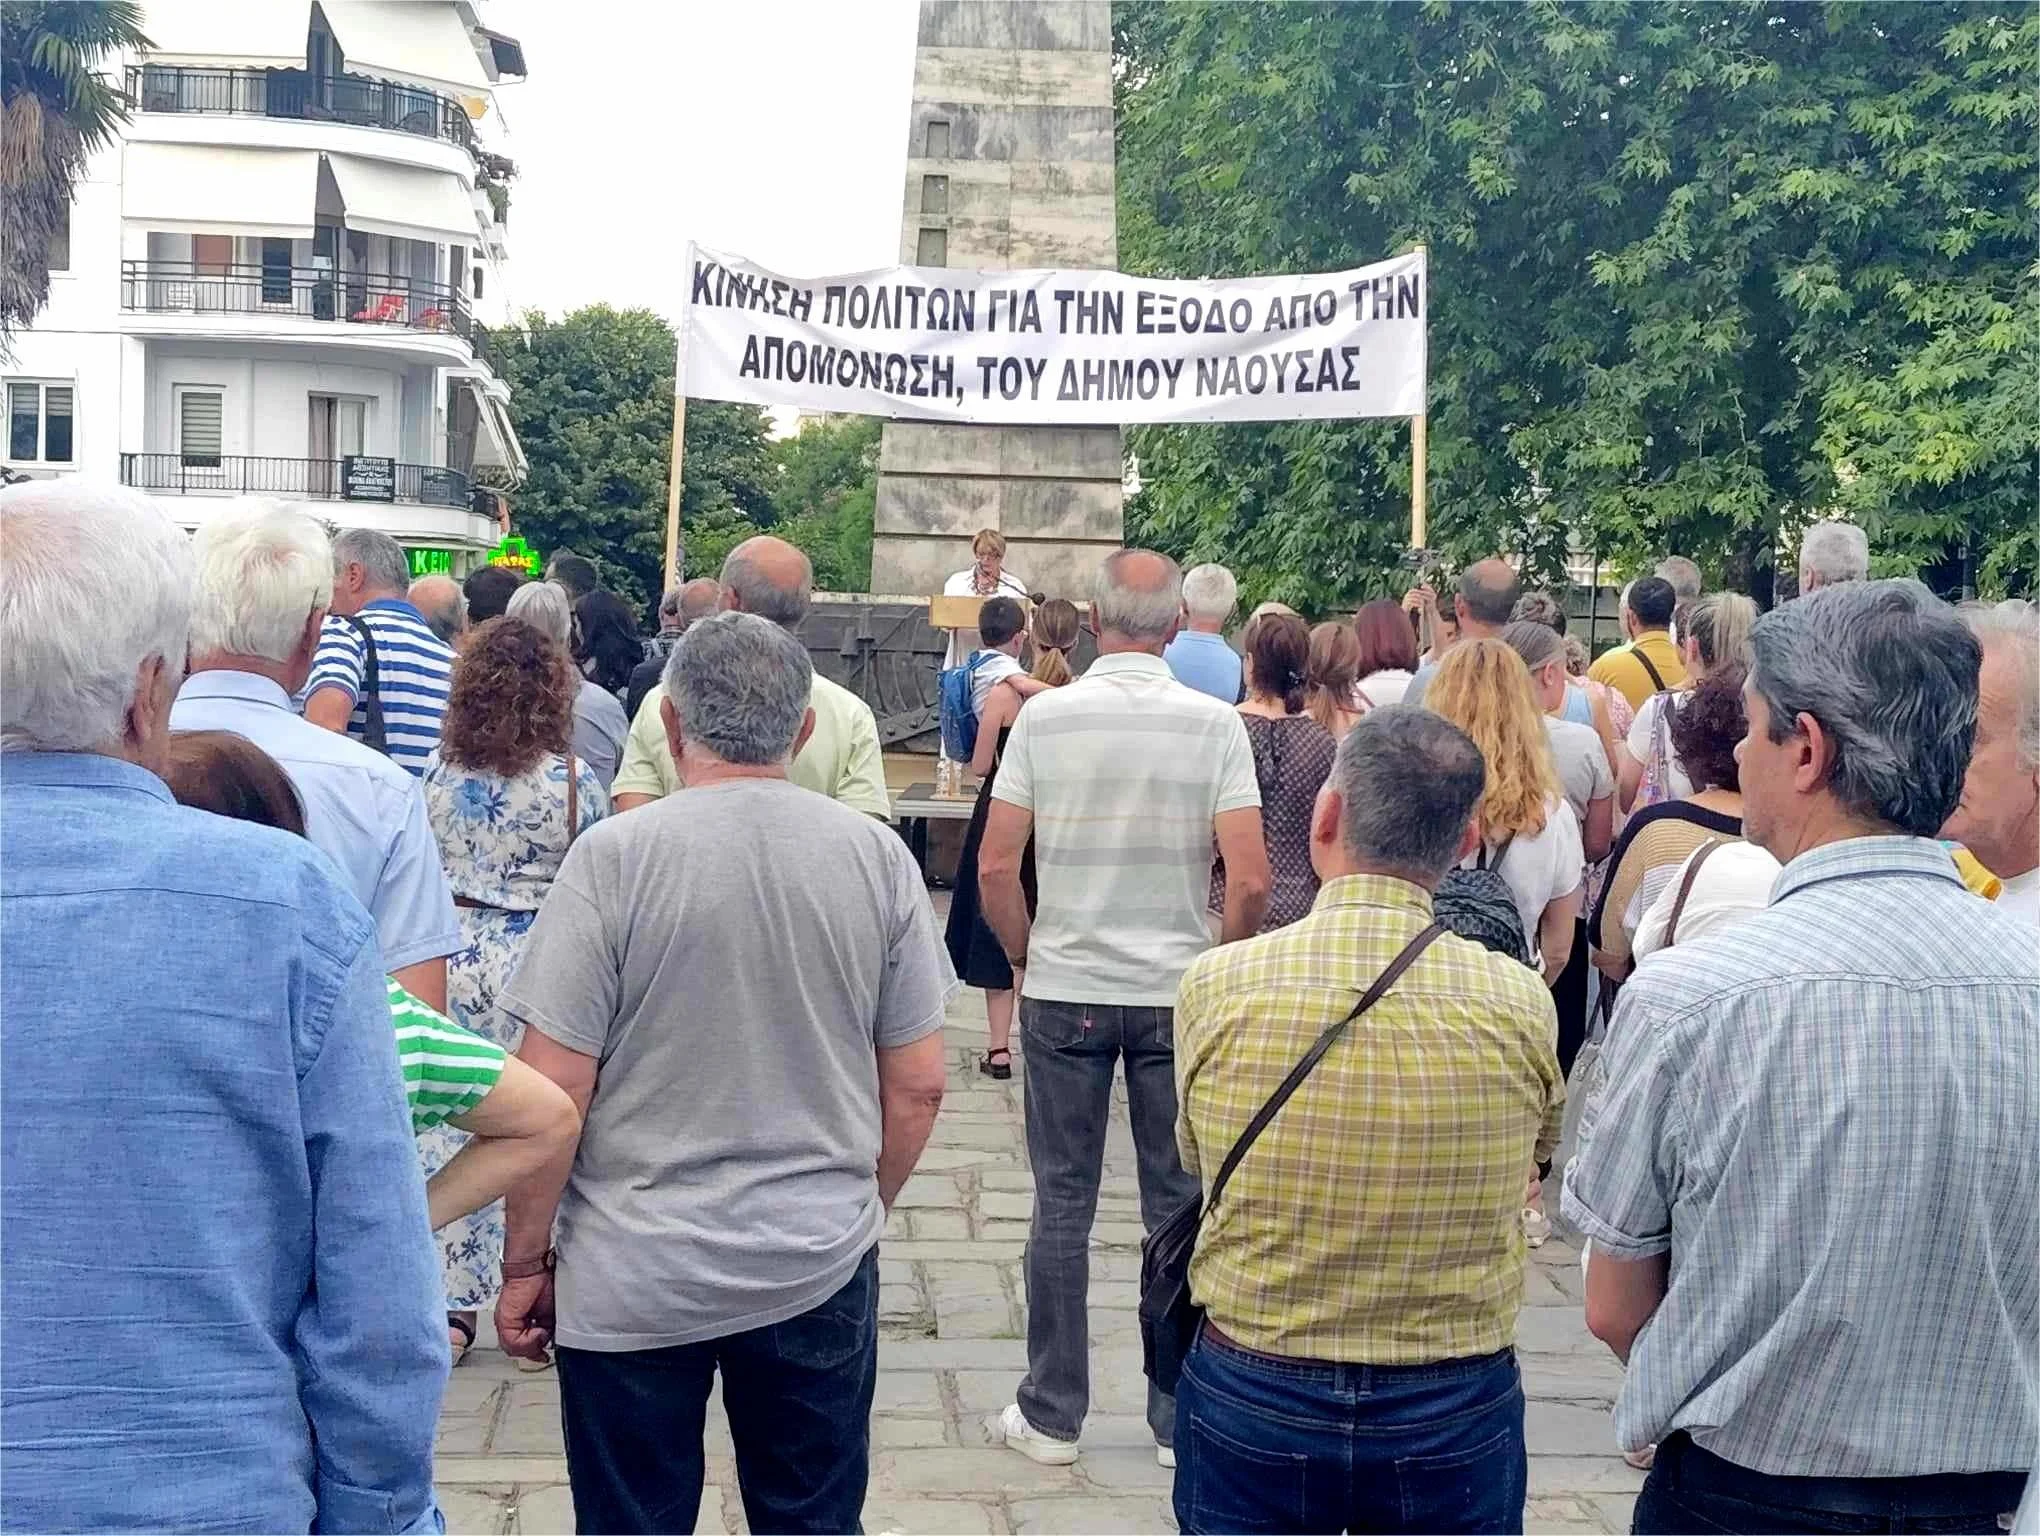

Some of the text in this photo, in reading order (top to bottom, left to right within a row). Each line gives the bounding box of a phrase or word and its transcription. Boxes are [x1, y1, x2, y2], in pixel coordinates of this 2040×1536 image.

[691, 260, 1420, 334] ΚΙΝΗΣΗ ΠΟΛΙΤΩΝ ΓΙΑ ΤΗΝ ΕΞΟΔΟ ΑΠΟ ΤΗΝ
[739, 334, 1362, 407] ΑΠΟΜΟΝΩΣΗ, ΤΟΥ ΔΗΜΟΥ ΝΑΟΥΣΑΣ
